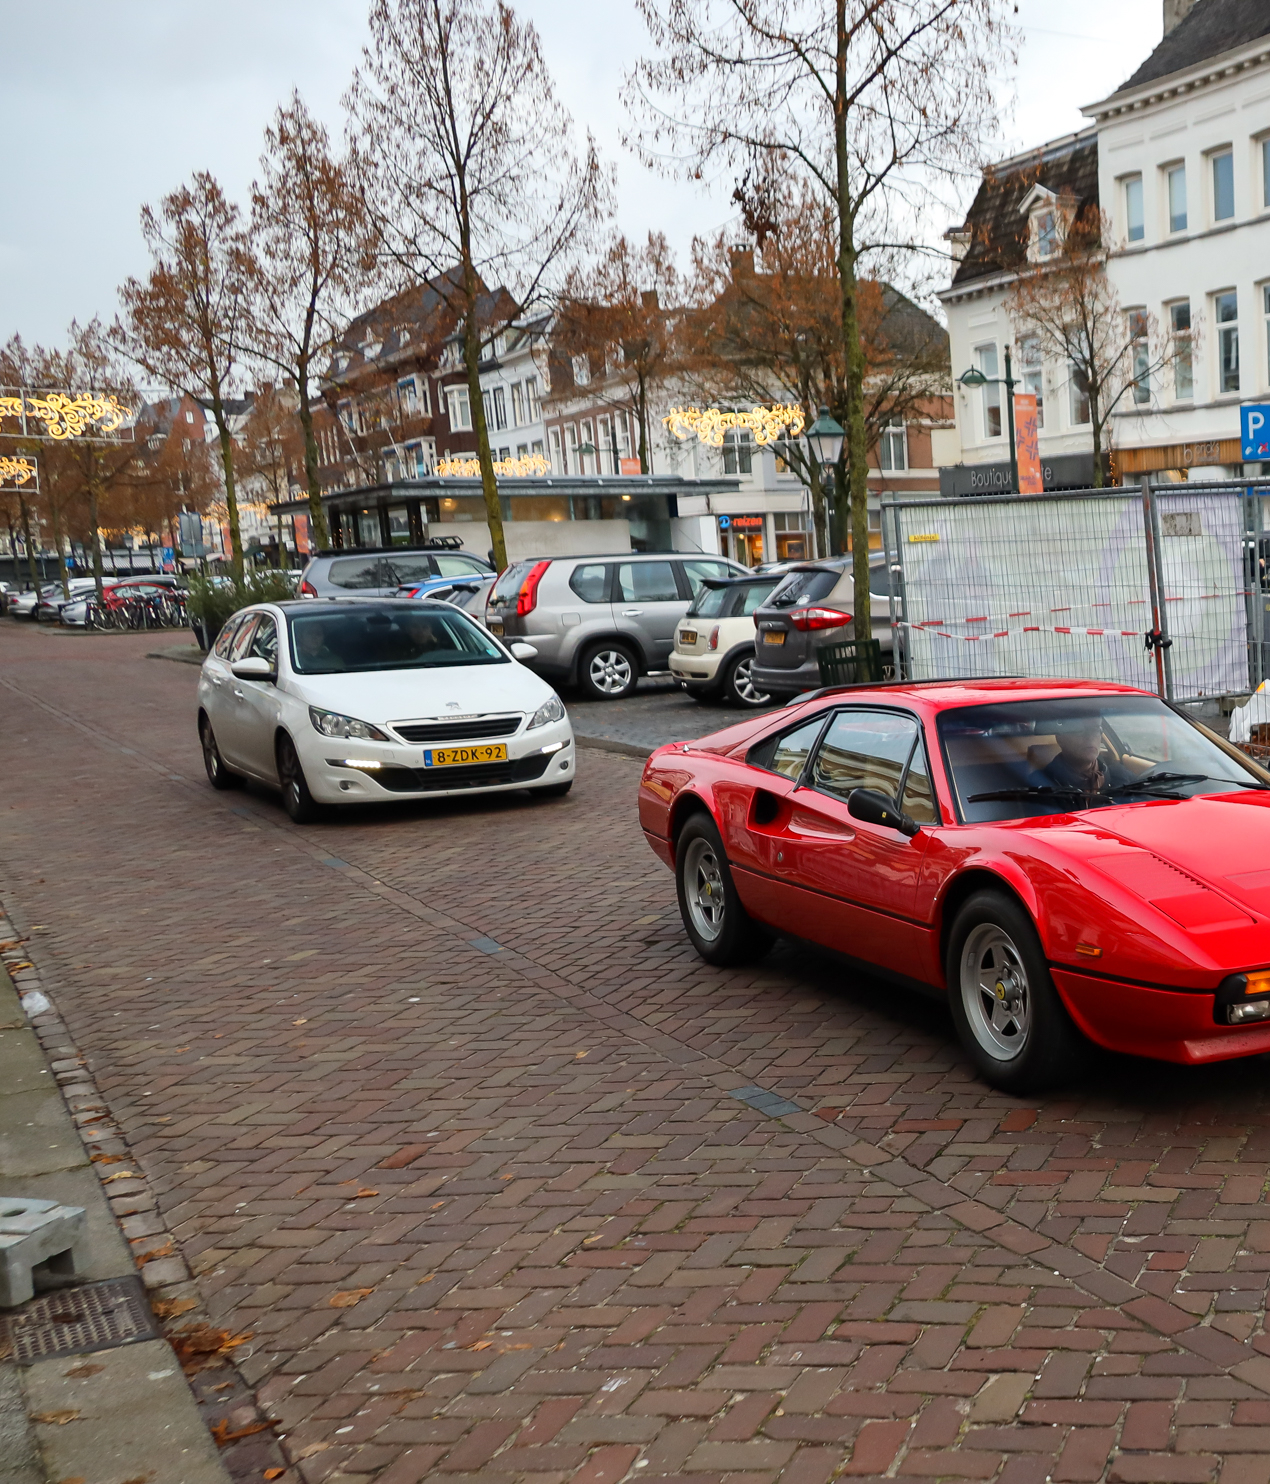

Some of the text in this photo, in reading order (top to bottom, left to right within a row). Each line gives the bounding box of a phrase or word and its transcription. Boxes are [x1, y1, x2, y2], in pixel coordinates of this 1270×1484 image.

[1248, 412, 1265, 440] P
[971, 469, 1012, 488] Boutique
[438, 746, 503, 763] 8-ZDK-92
